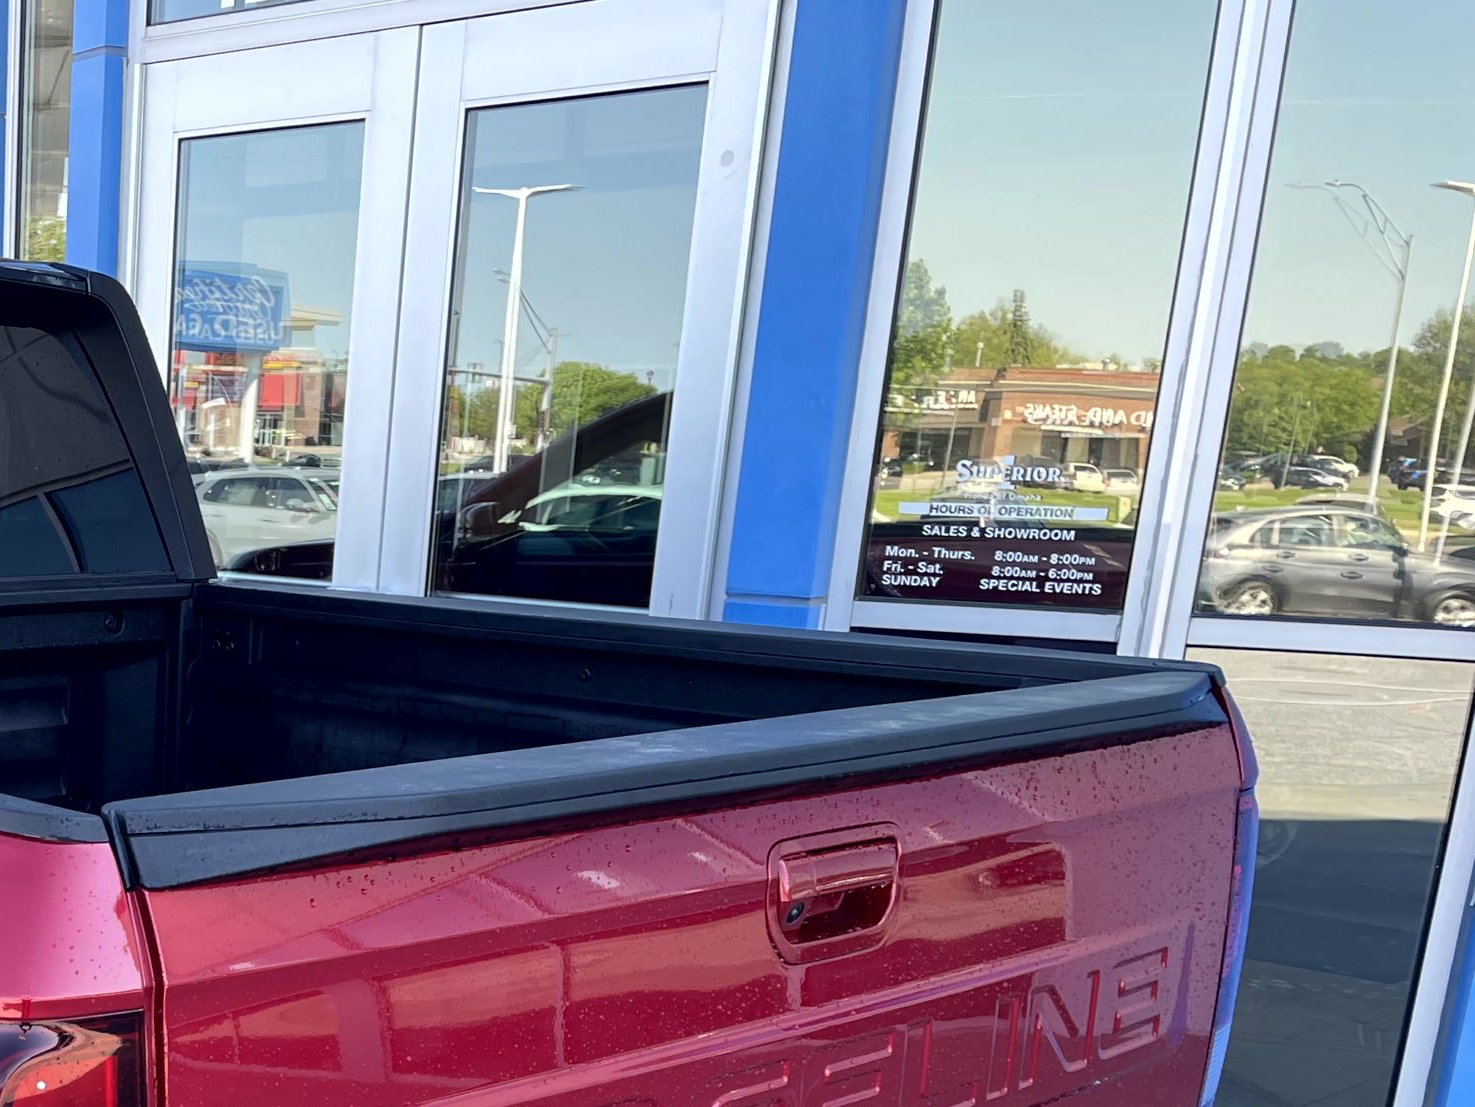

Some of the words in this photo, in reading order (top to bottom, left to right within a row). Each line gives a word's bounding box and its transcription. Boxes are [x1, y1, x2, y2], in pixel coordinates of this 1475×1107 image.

[929, 503, 974, 515] HOURS
[998, 506, 1074, 518] OPERATION
[922, 524, 968, 537] SALES
[971, 528, 981, 537] &
[984, 527, 1076, 541] SHOWROOM
[885, 545, 920, 558] Mon.
[932, 547, 975, 560] Thurs.
[882, 560, 905, 573] Fri.
[917, 561, 944, 575] Sat.
[881, 574, 940, 587] SUNDAY
[979, 579, 1040, 592] SPECIAL
[1044, 582, 1102, 595] EVENTS
